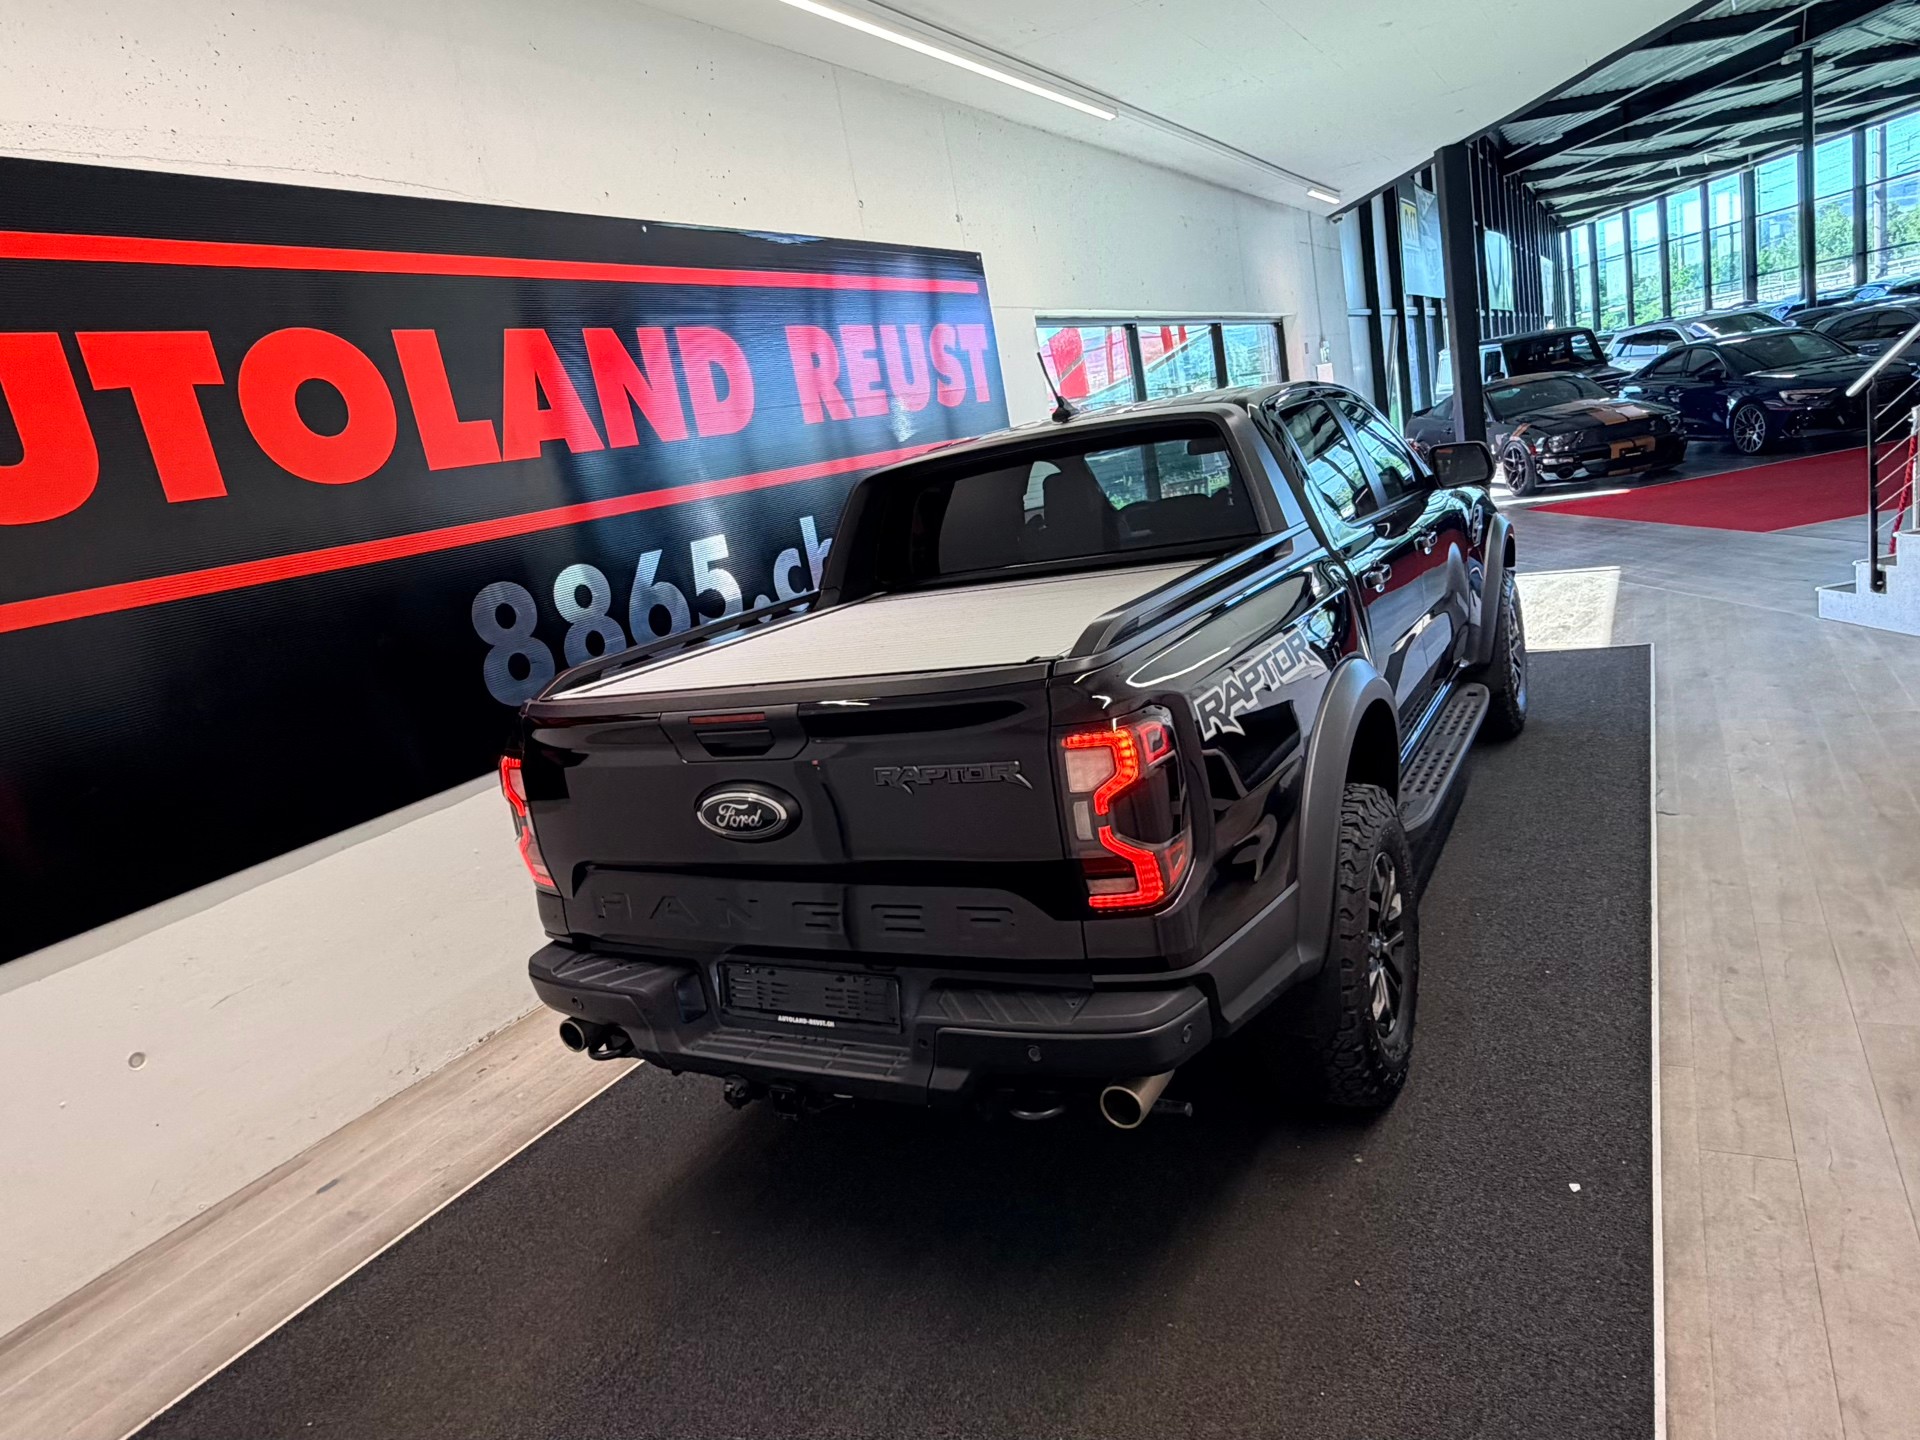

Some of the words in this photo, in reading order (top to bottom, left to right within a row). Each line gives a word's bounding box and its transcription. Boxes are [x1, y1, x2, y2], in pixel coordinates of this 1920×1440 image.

[785, 323, 991, 425] REUST
[1193, 627, 1328, 742] RAPTOR
[873, 760, 1033, 796] RAPTOR
[716, 803, 762, 827] Ford
